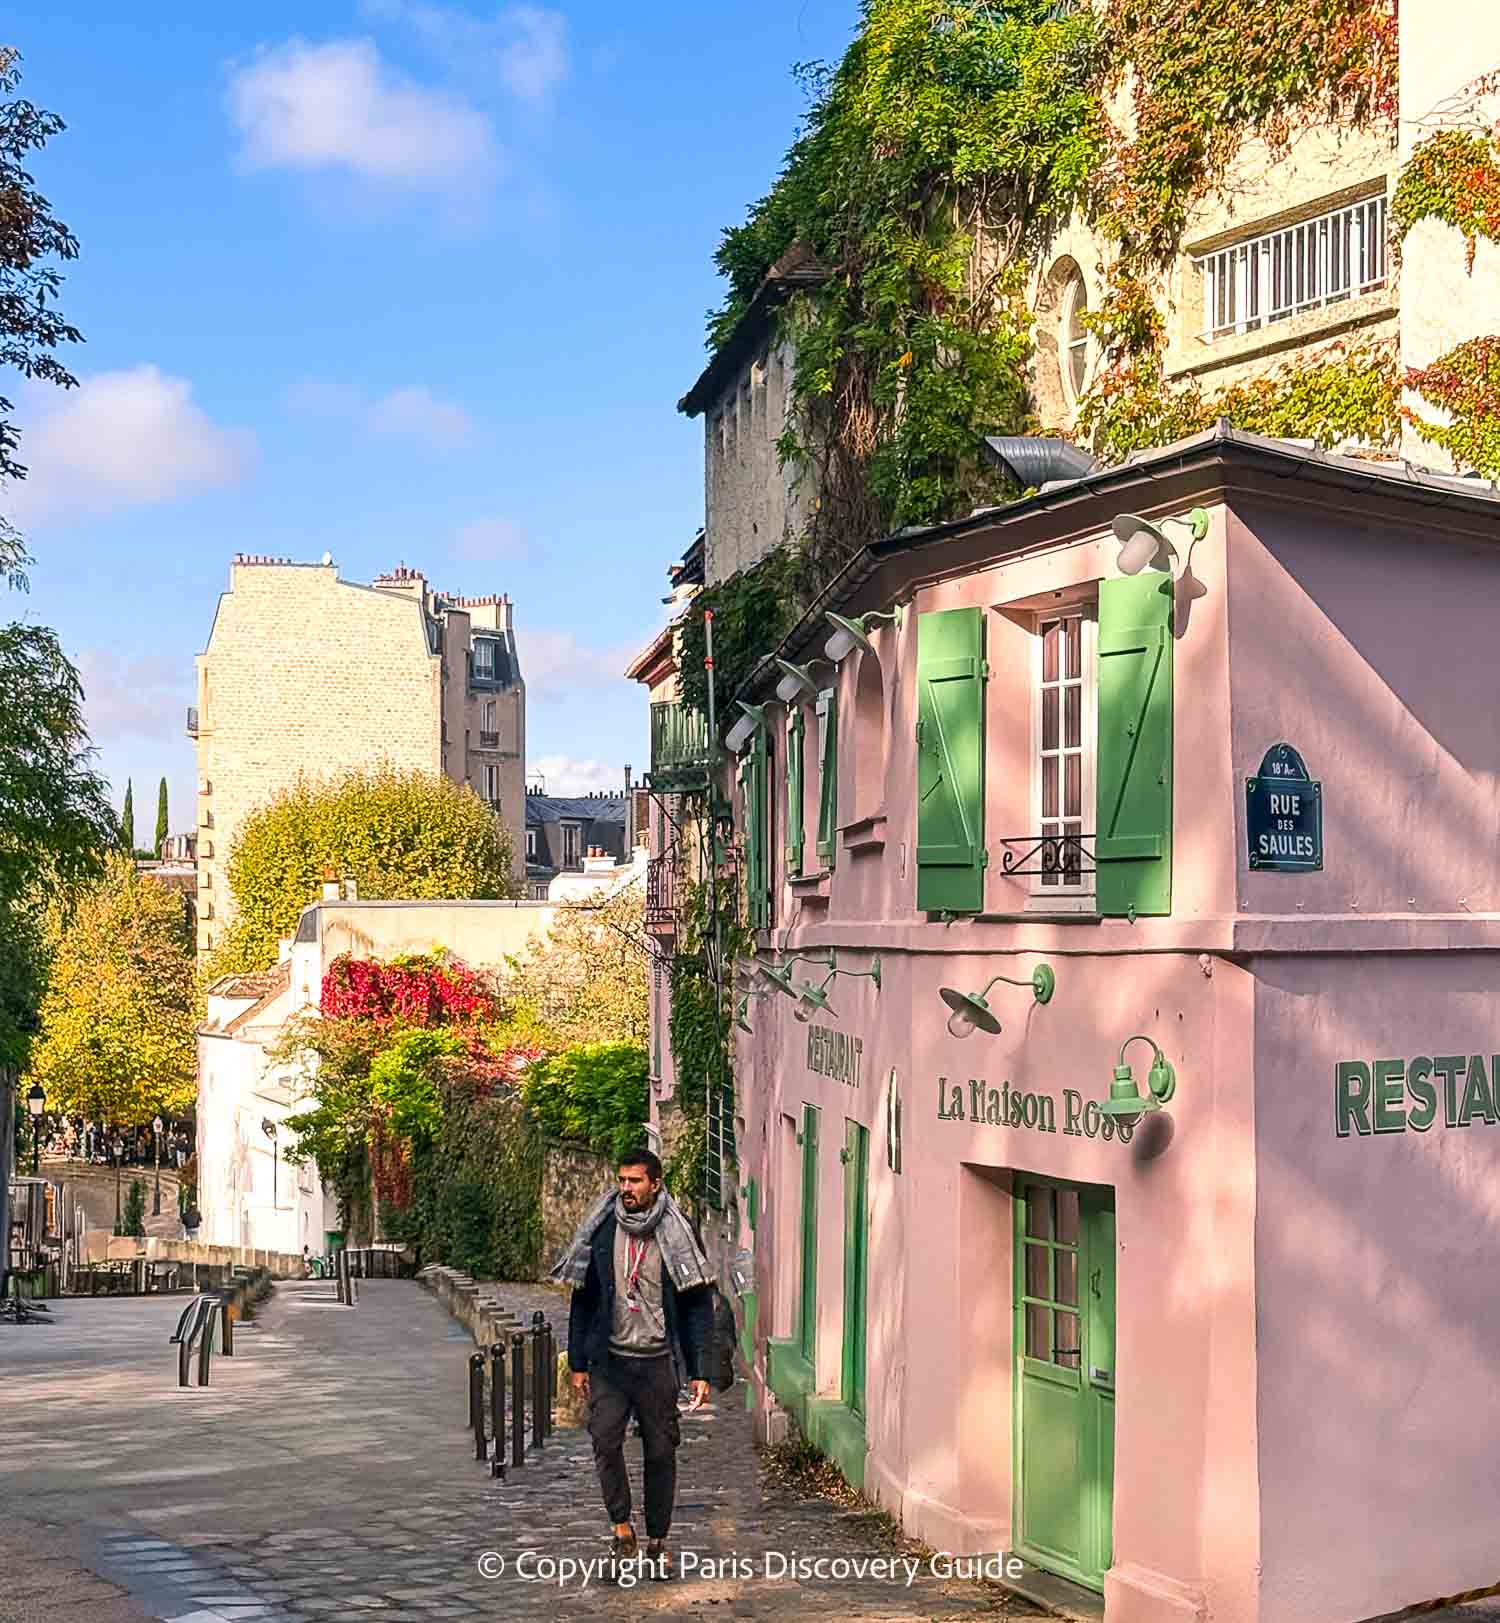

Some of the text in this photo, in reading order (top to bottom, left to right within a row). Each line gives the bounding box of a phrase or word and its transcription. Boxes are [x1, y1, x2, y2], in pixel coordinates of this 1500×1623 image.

[1270, 794, 1300, 816] RUE
[1277, 819, 1294, 831] DES
[1259, 834, 1313, 857] SAULES
[808, 1023, 863, 1089] RESTAURANT
[937, 1077, 965, 1121] La
[968, 1079, 1057, 1134] Maison
[1335, 1055, 1500, 1138] RESTA
